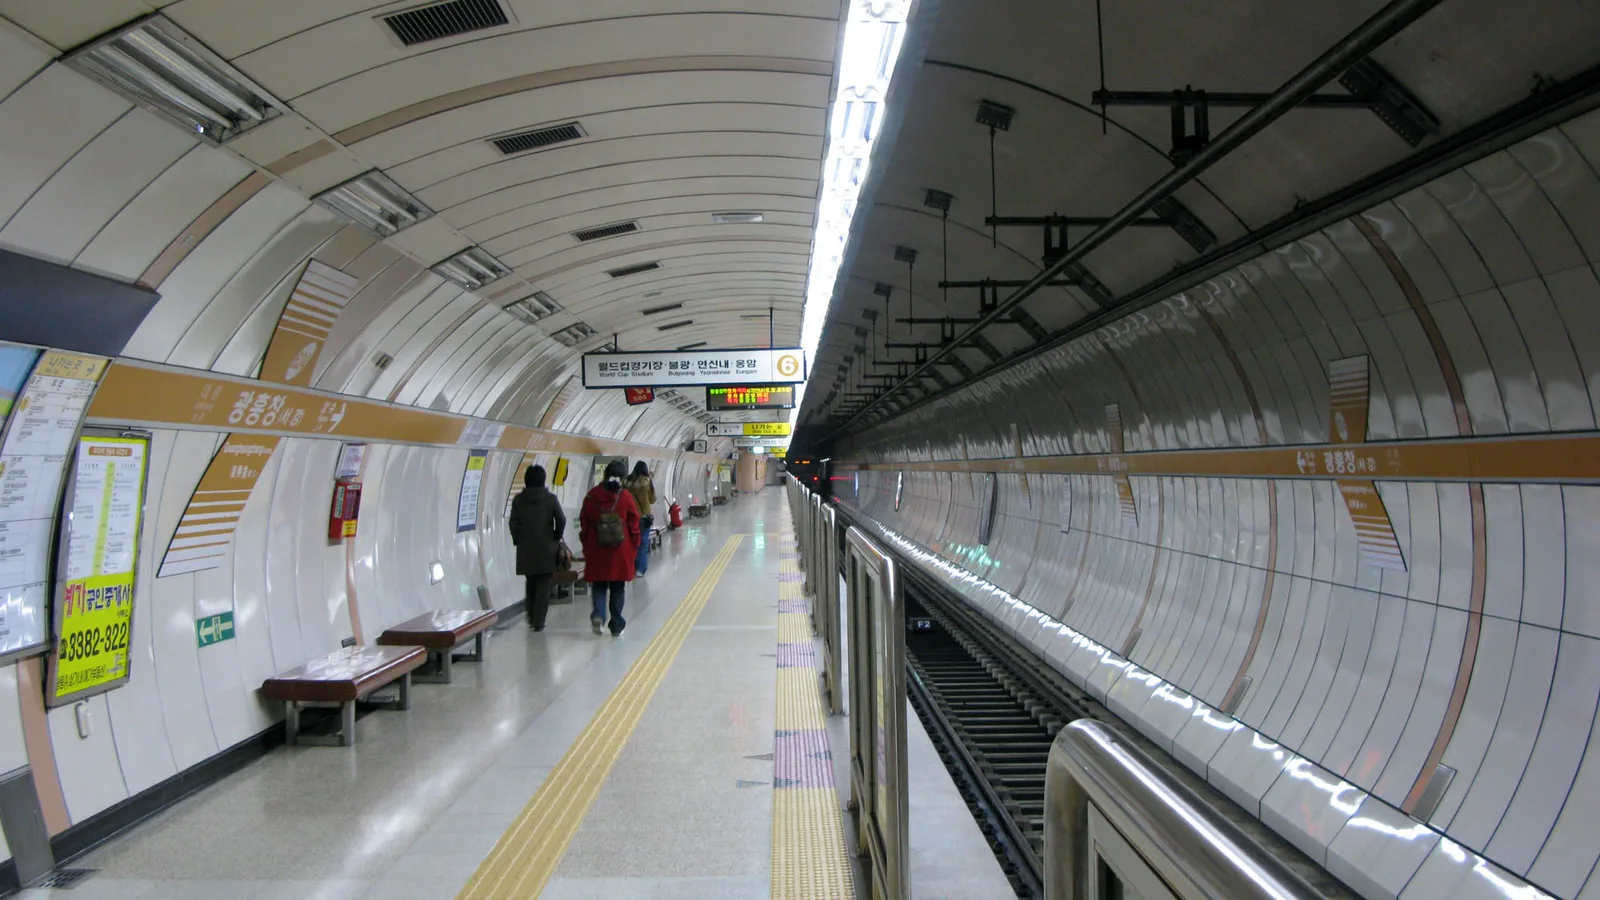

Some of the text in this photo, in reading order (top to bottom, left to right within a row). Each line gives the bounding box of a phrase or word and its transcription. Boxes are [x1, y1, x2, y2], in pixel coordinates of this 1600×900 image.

[598, 361, 662, 371] 월드컵경기장
[698, 360, 729, 369] 연신내
[87, 583, 131, 612] 공인중개사
[917, 620, 931, 628] F2
